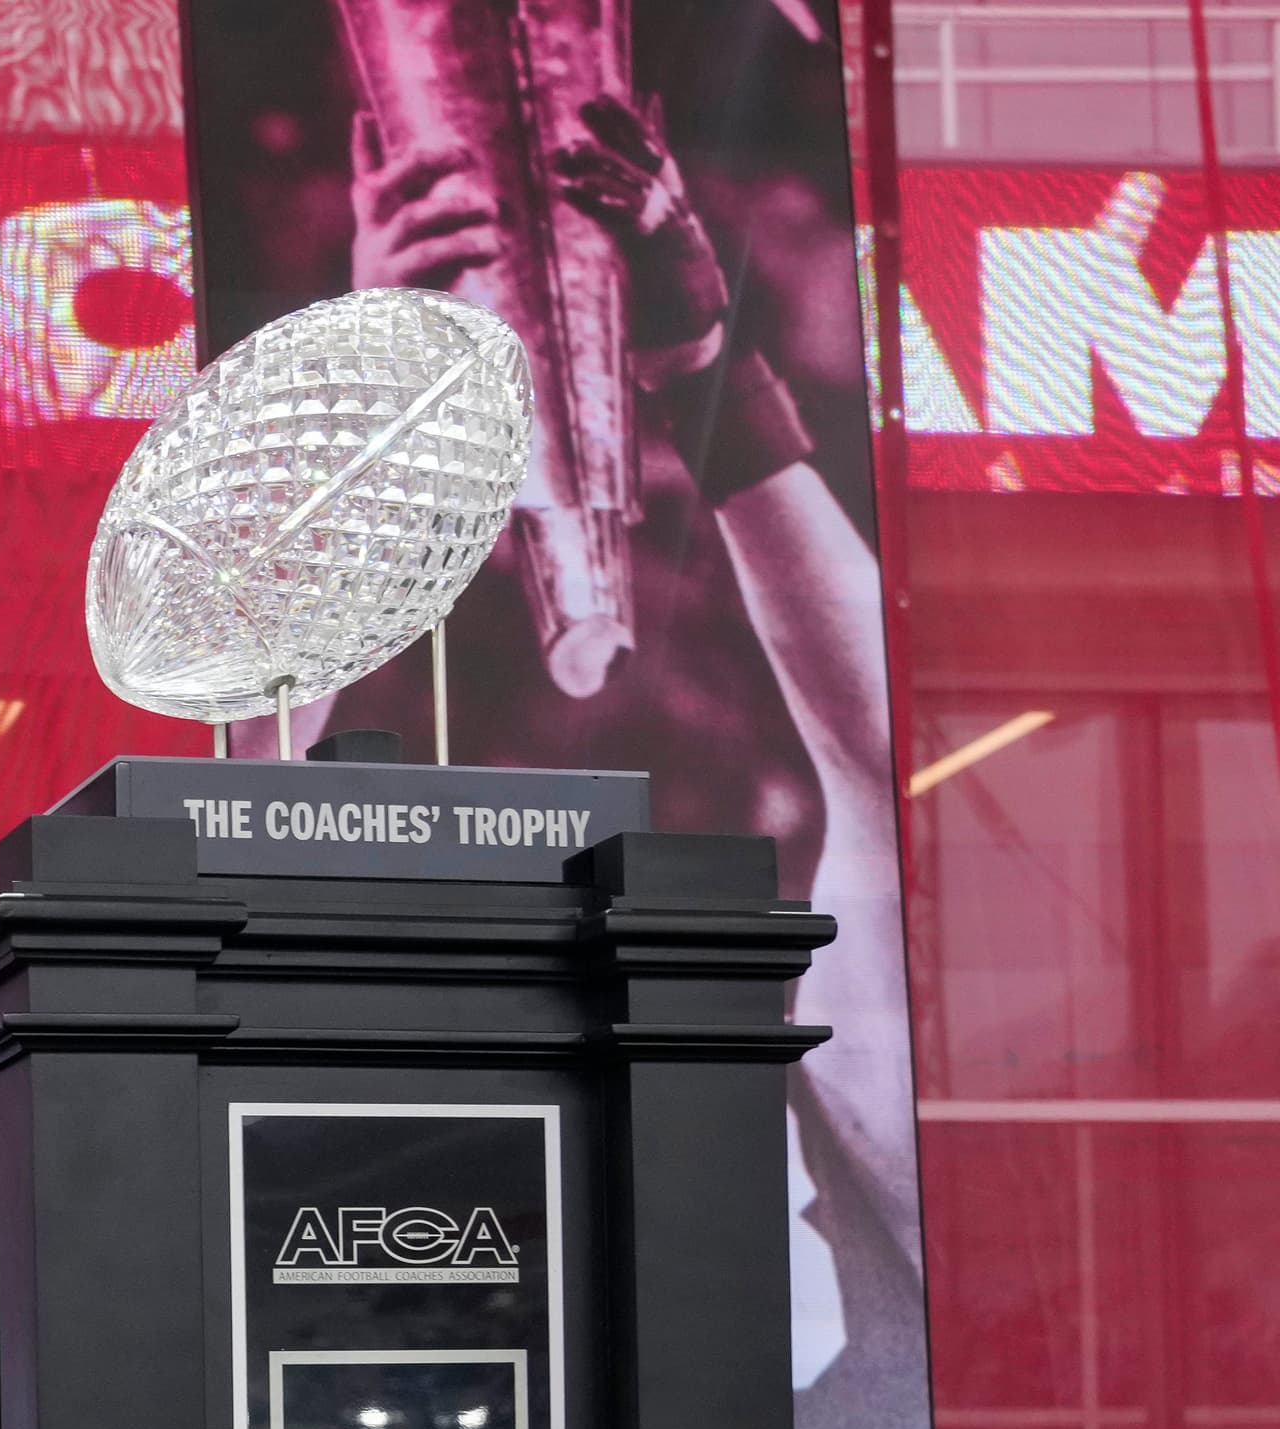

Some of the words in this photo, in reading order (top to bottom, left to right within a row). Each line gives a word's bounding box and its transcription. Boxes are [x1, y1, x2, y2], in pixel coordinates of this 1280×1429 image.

[183, 799, 253, 839] THE
[453, 806, 591, 848] TROPHY
[275, 1206, 519, 1265] AFCA
[278, 1271, 336, 1281] AMERICAN
[337, 1271, 389, 1281] FOOTBALL
[394, 1270, 443, 1281] COACHES
[448, 1270, 516, 1281] ASSOCIATION
